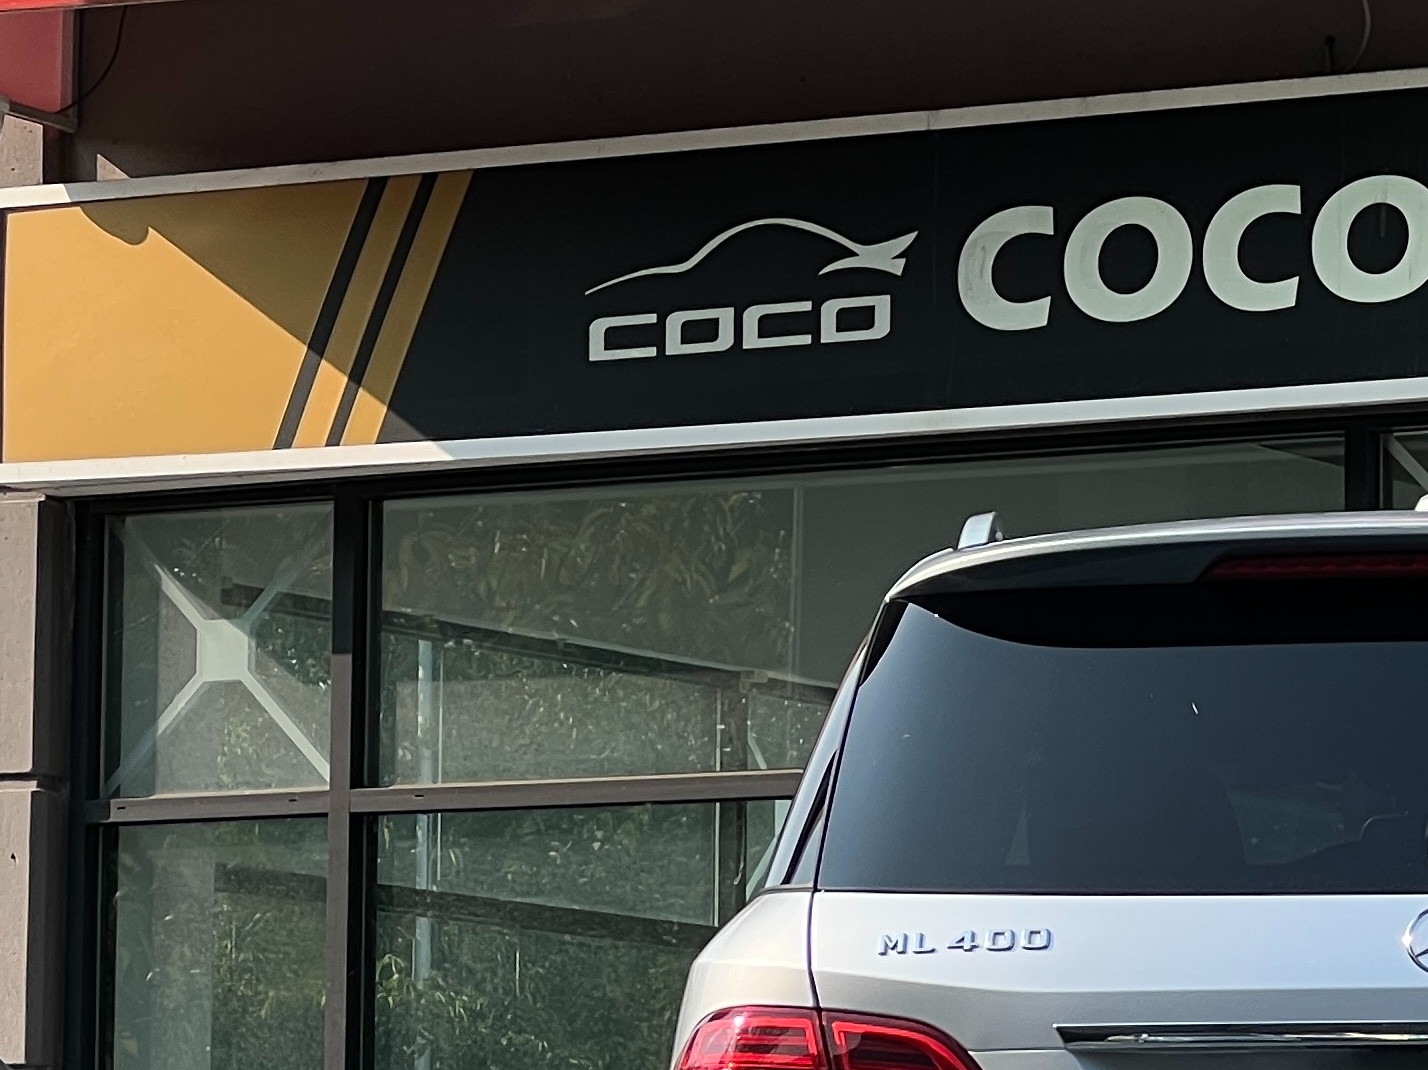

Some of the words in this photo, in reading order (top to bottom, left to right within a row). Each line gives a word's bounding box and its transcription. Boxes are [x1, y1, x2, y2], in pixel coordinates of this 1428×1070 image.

[588, 294, 891, 362] COCO
[877, 932, 938, 957] ML
[946, 927, 1053, 953] 400
